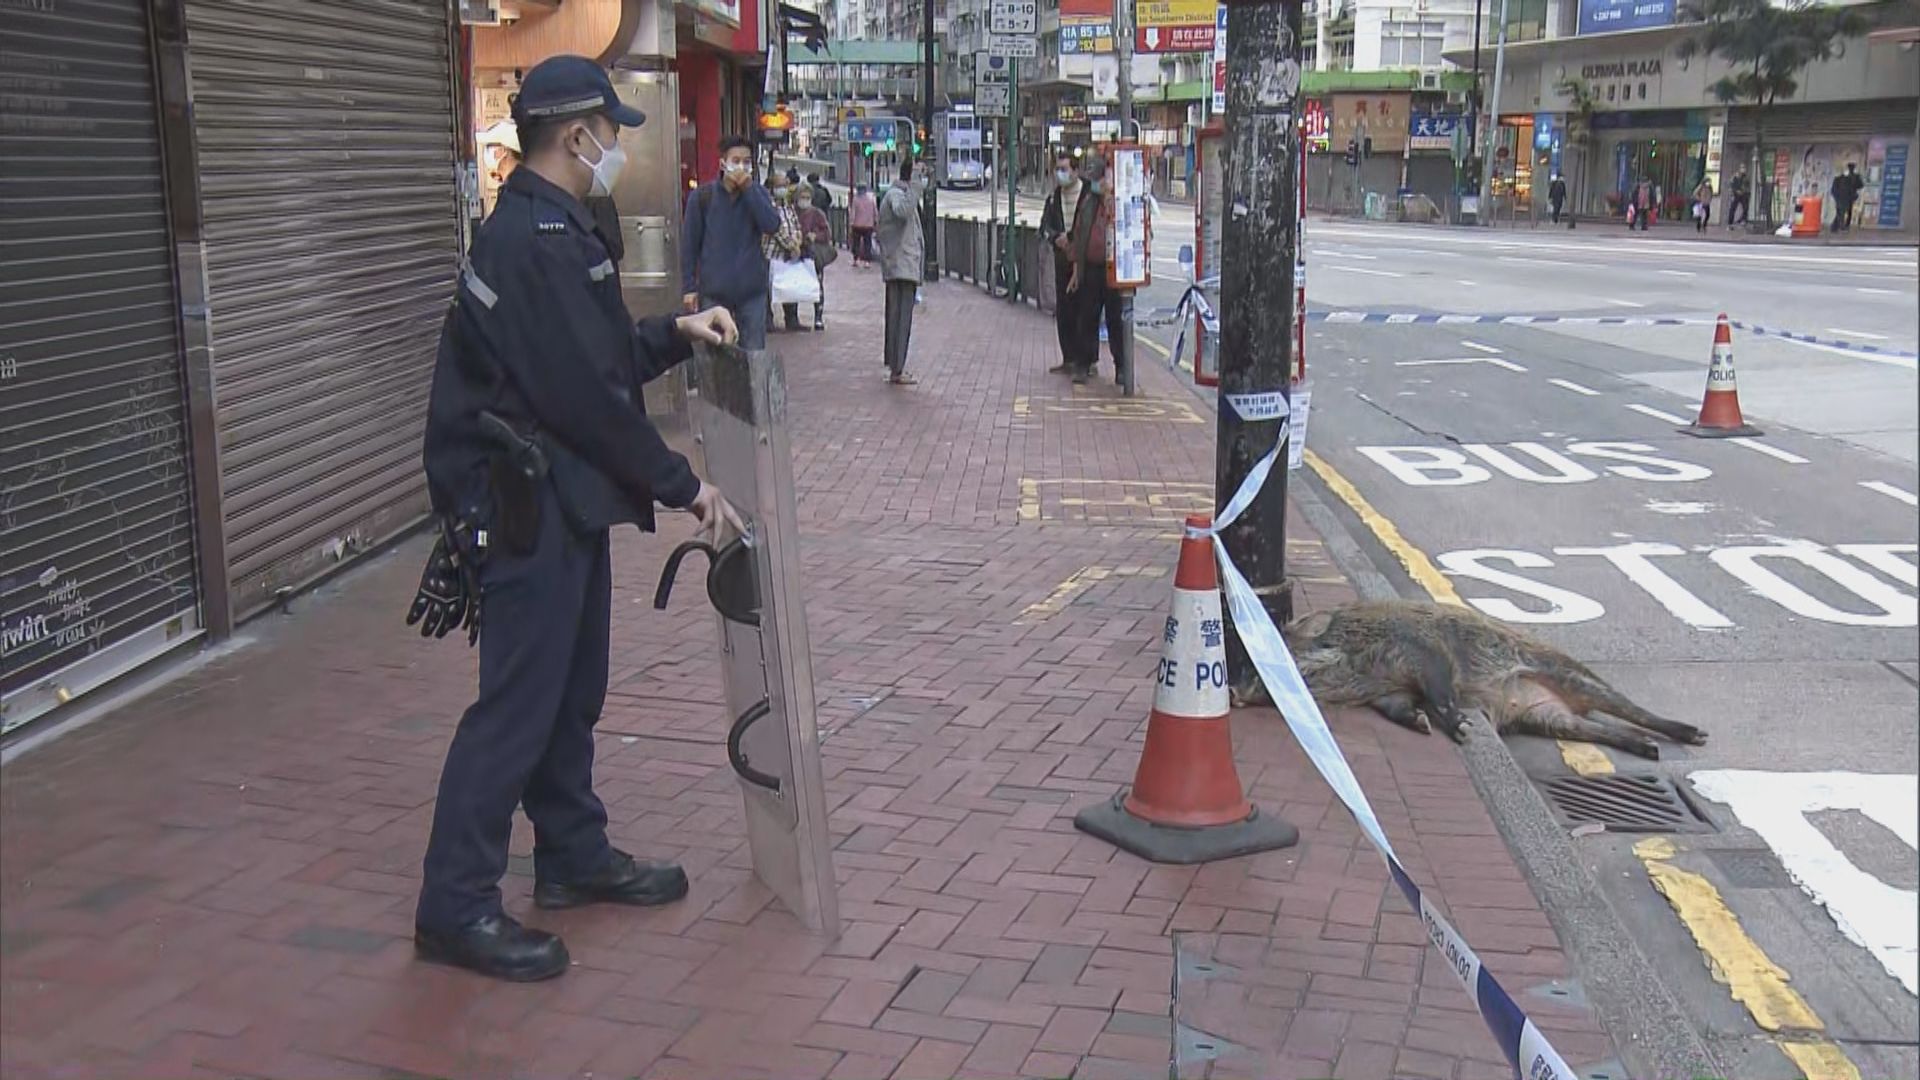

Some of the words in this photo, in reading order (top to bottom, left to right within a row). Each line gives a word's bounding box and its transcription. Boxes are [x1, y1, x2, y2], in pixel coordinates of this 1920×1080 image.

[1185, 13, 1213, 21] District
[1626, 60, 1661, 77] PLAZA
[1355, 441, 1714, 486] BUS
